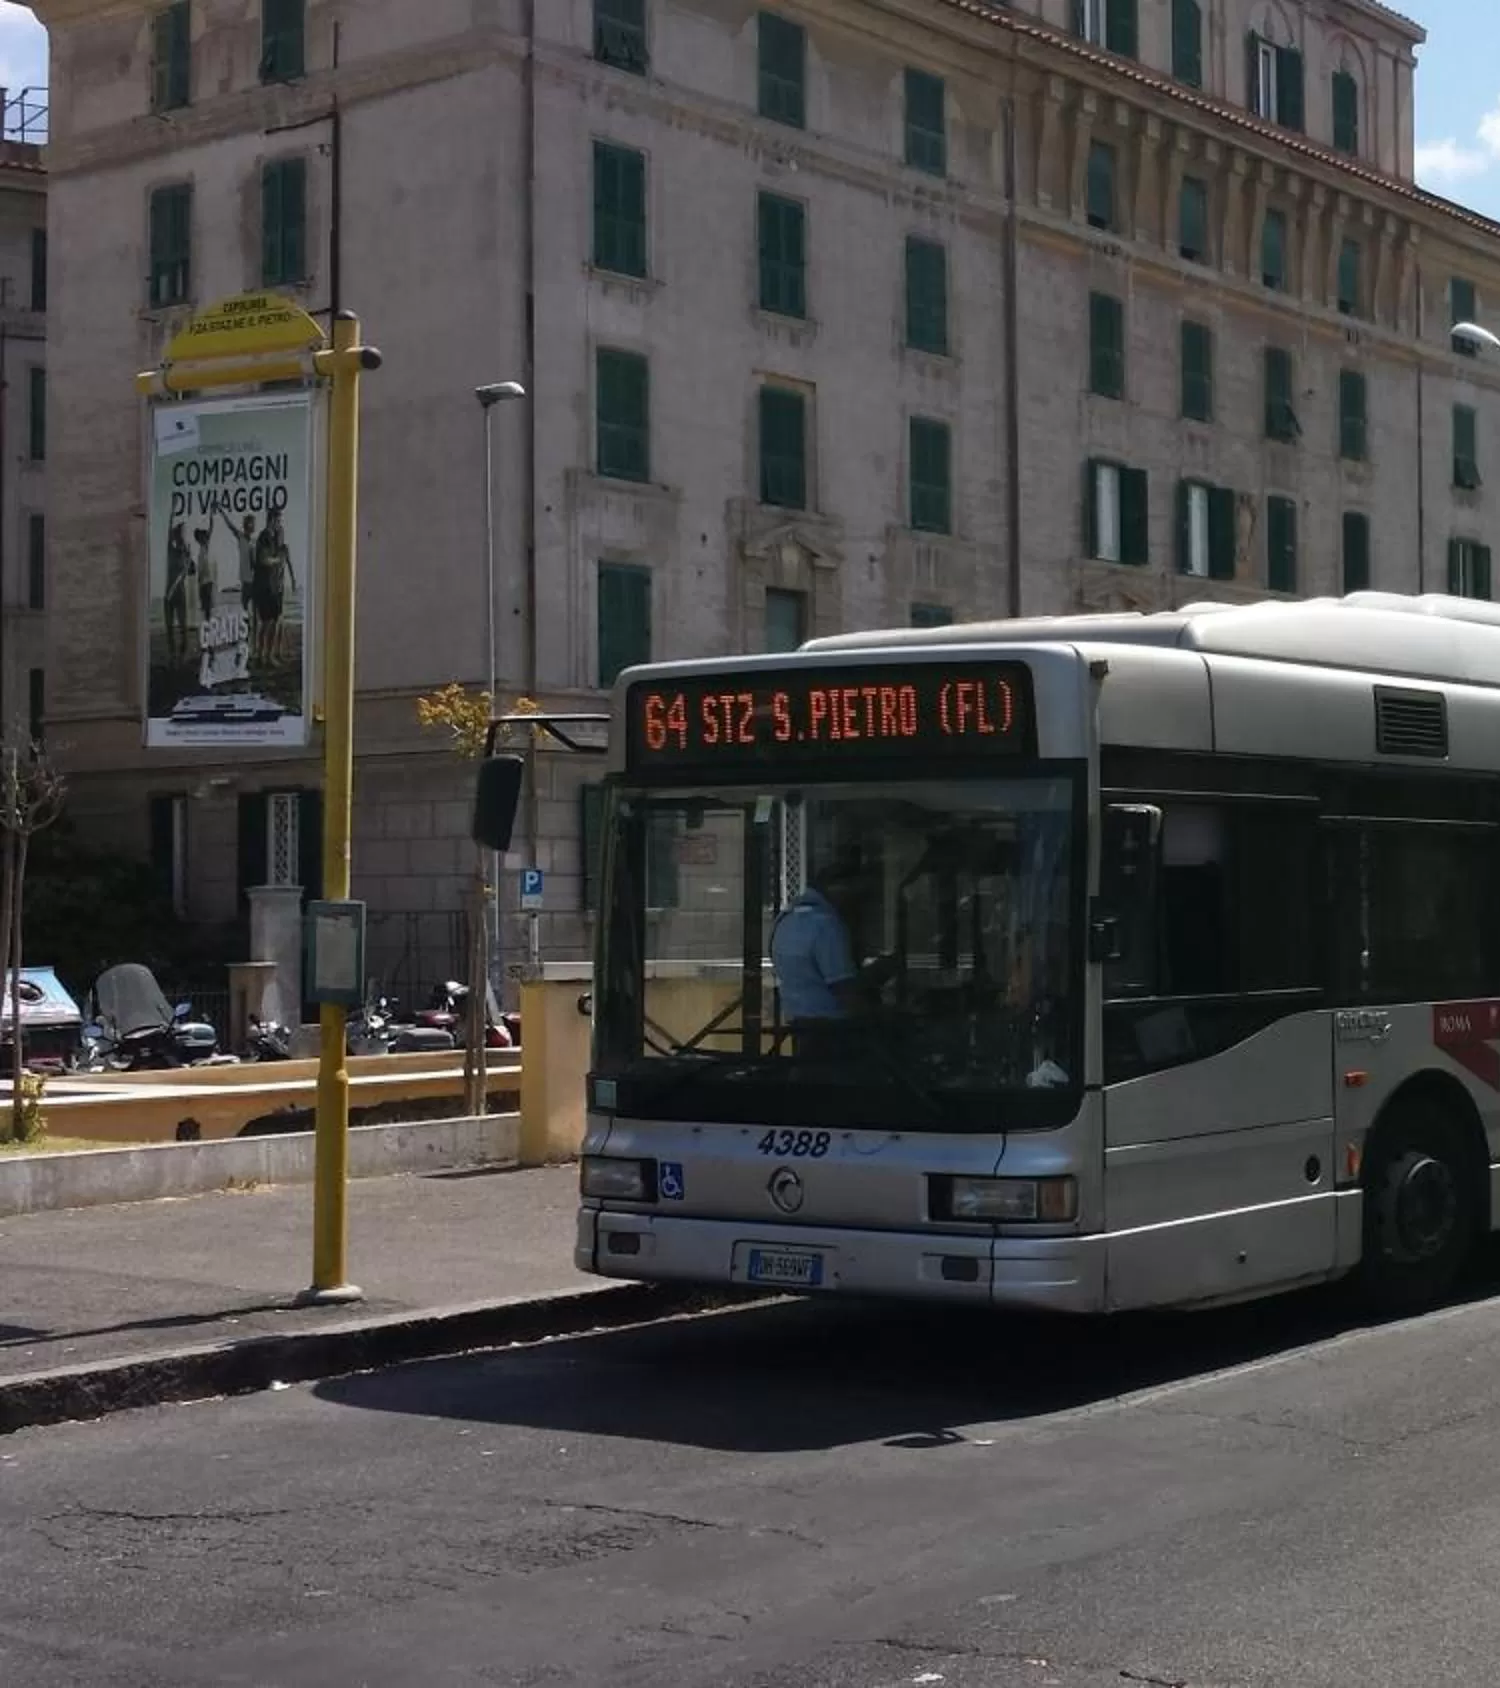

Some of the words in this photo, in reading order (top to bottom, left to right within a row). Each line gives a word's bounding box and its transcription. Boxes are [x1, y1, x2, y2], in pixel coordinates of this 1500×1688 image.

[173, 452, 289, 488] COMPAGNI
[171, 491, 193, 517] DI
[197, 484, 289, 516] VIAGGIO
[645, 692, 688, 750] 64
[772, 685, 918, 741] S.PIETRO
[939, 681, 1013, 734] (FL)
[525, 871, 539, 893] P
[1440, 1014, 1471, 1033] ROMA
[757, 1129, 831, 1158] 4388
